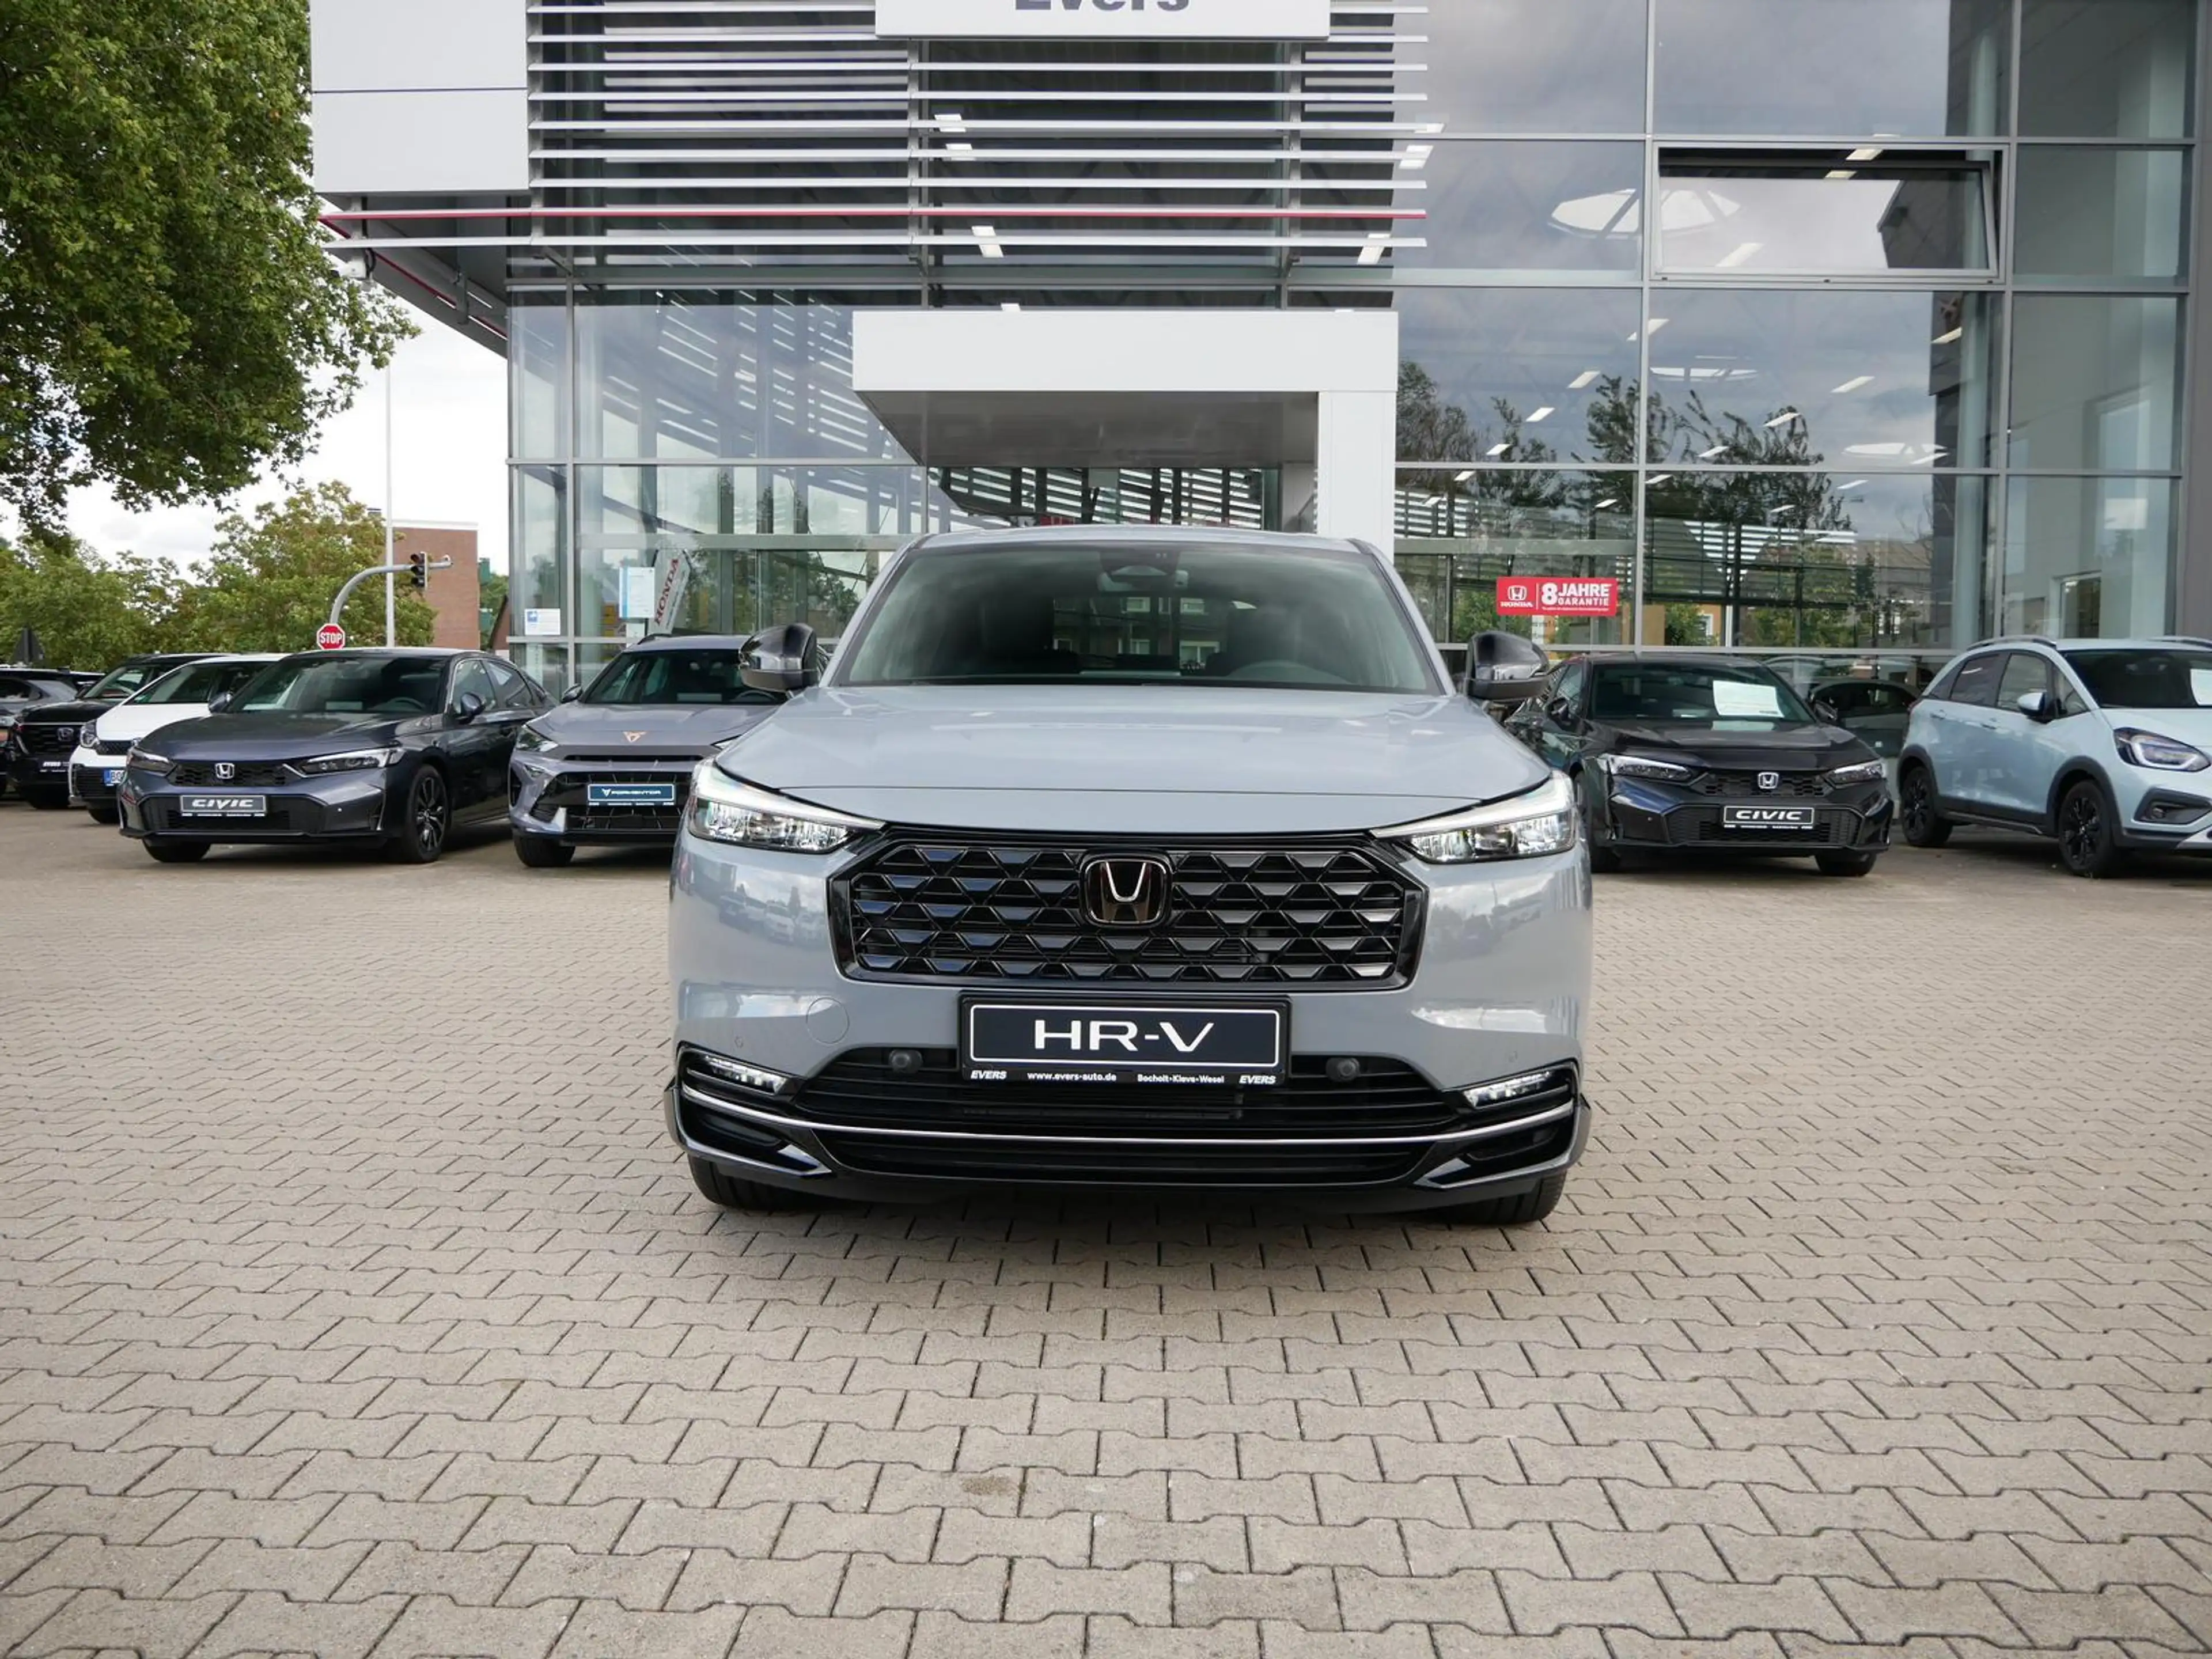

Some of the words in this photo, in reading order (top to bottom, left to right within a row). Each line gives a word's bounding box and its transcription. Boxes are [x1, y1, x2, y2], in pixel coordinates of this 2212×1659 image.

[655, 559, 679, 626] HONDA
[1541, 582, 1558, 605] 8
[1558, 583, 1610, 597] JAHRE
[1558, 598, 1609, 606] GARANTIE
[320, 632, 342, 644] STOP
[192, 799, 254, 809] CIVIC
[1736, 810, 1802, 820] CIVIC
[1035, 1020, 1214, 1052] HR-V
[970, 1070, 1007, 1080] EVERS
[1027, 1072, 1117, 1081] www.evers-auto.de
[1239, 1075, 1277, 1084] EVERS
